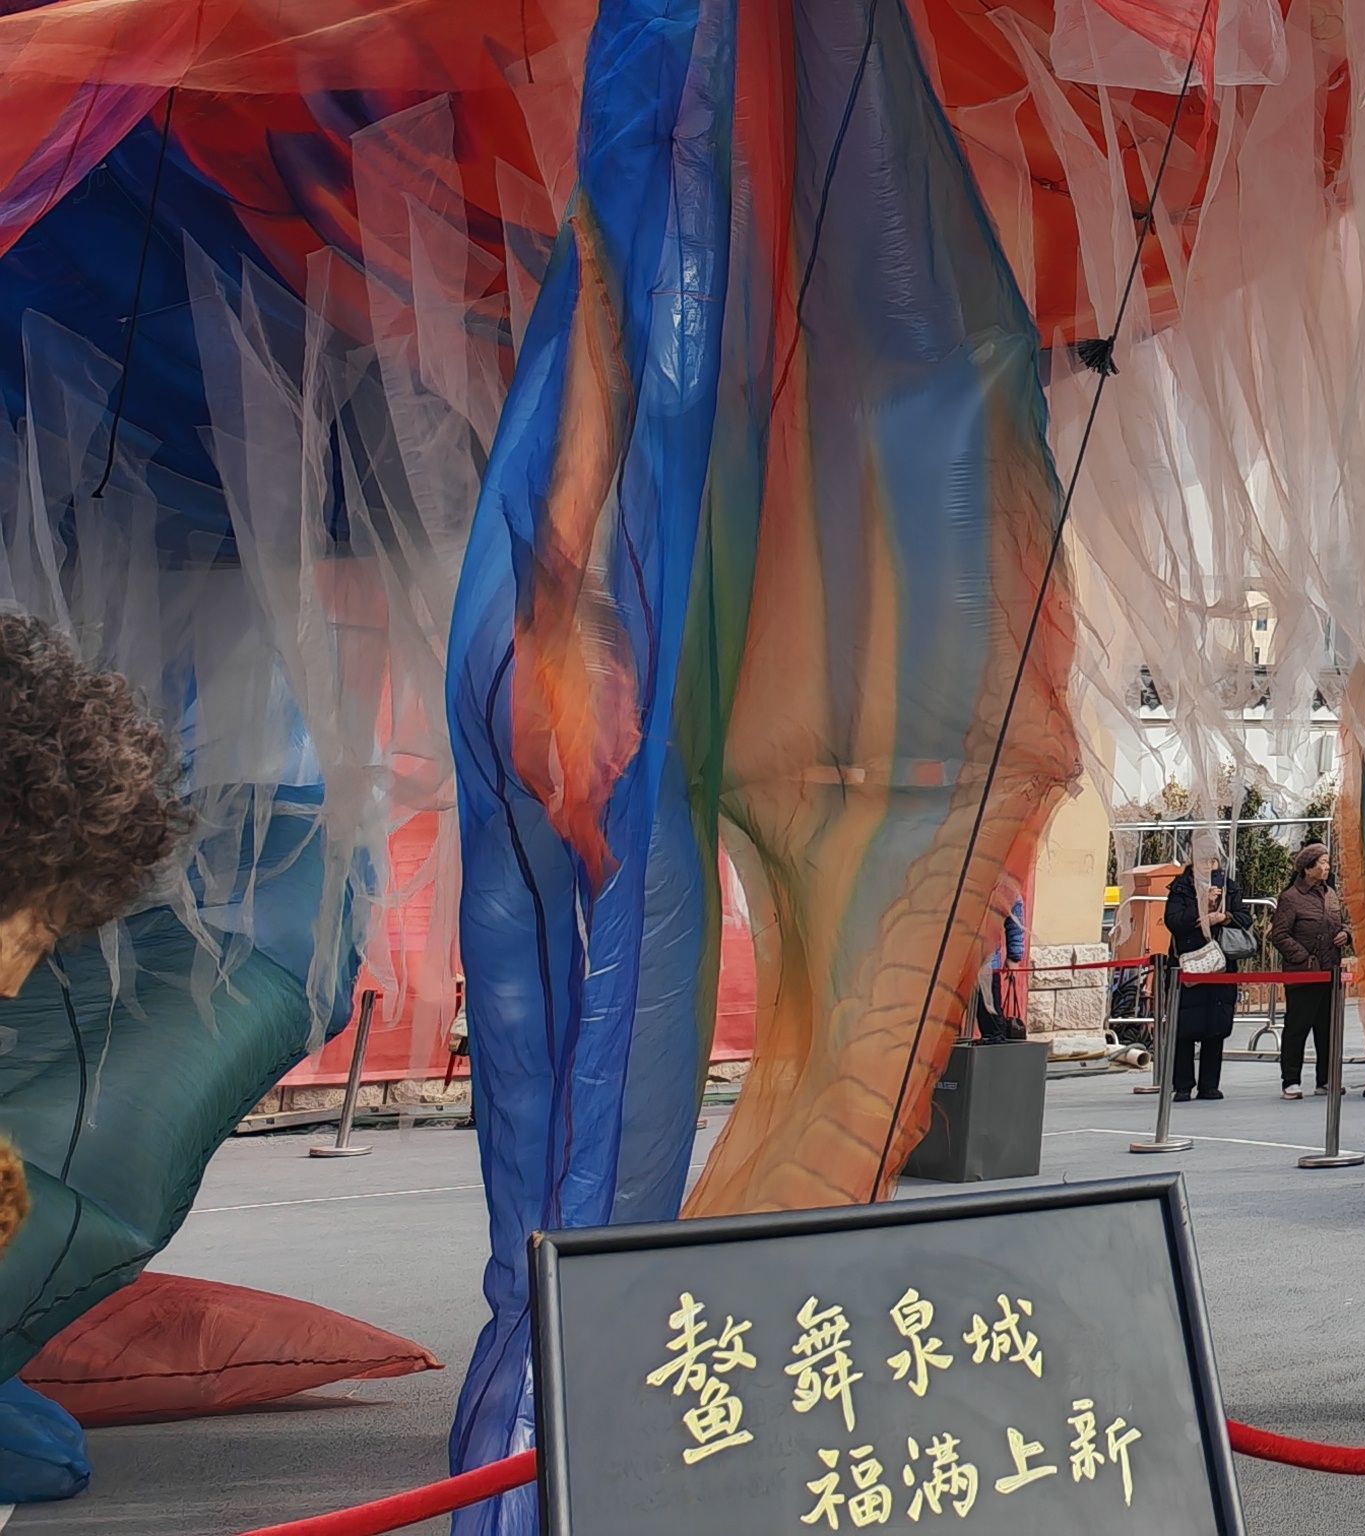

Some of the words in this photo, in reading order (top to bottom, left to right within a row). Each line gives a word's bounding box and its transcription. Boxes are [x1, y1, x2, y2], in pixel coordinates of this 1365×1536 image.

[647, 1287, 1043, 1464] 鳌舞泉城
[800, 1398, 1143, 1530] 福满上新
